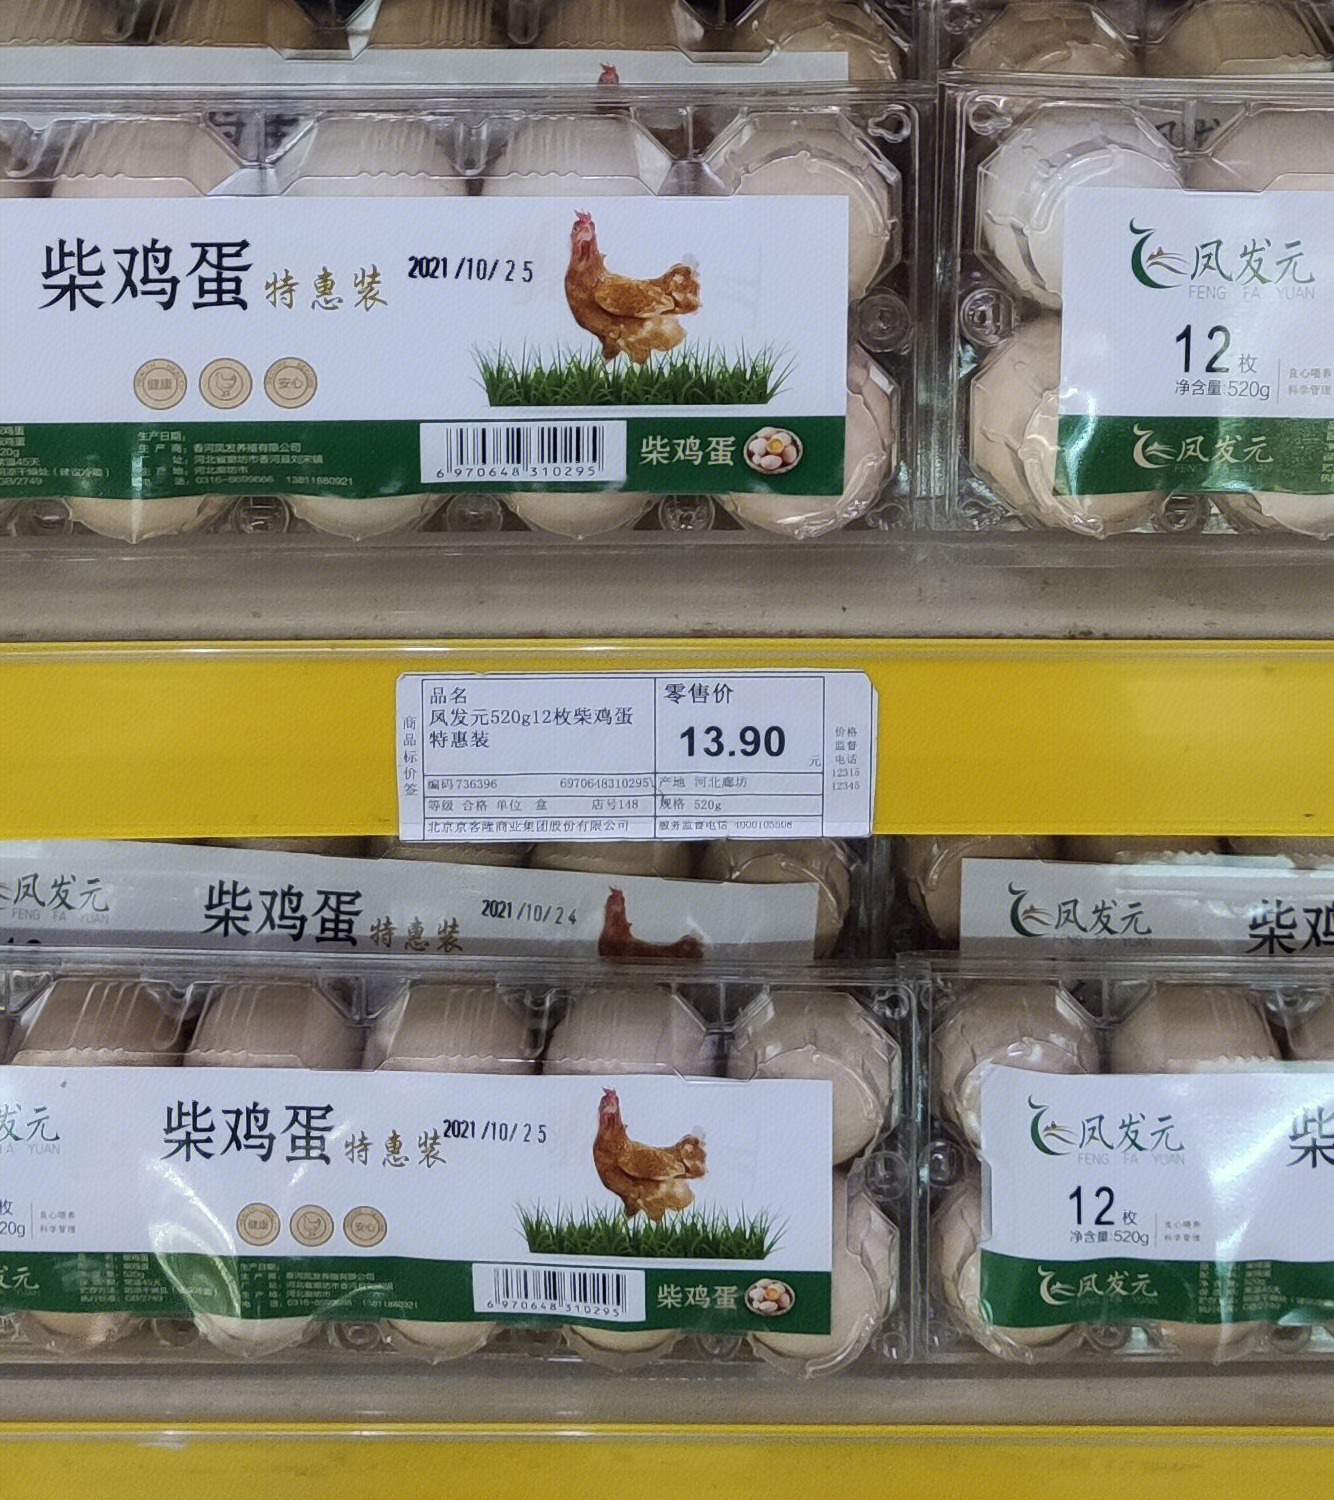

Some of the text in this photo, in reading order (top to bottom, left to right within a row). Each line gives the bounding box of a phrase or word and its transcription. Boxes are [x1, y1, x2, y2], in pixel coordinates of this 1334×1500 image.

[38, 237, 254, 313] 柴鸡蛋
[1190, 237, 1316, 286] 凤发元
[264, 263, 388, 312] 特惠装
[1190, 285, 1315, 300] FENG FA YUAN
[639, 435, 736, 467] 柴鸡蛋
[1176, 435, 1274, 464] 凤发元
[430, 683, 734, 704] 品名 零售价
[429, 731, 489, 748] 特惠装
[835, 726, 857, 737] 价格
[835, 740, 857, 751] 监督
[402, 715, 417, 796] 商品标价签
[680, 726, 821, 767] 13.90 元
[836, 754, 856, 764] 电话
[695, 776, 747, 788] 河北廊坊
[832, 767, 860, 777] 12315
[429, 799, 454, 810] 等级
[462, 799, 488, 810] 合格
[497, 799, 522, 810] 单位
[536, 799, 548, 810] 盒
[660, 798, 721, 811] 规格 520g
[14, 873, 110, 913] 凤发元
[200, 880, 364, 947] 柴鸡蛋
[1055, 899, 1153, 936] 凤发元
[370, 917, 463, 953] 特惠装
[161, 1100, 334, 1163] 柴鸡蛋
[1079, 1113, 1185, 1152] 凤发元
[28, 1143, 60, 1155] YUAN
[344, 1128, 446, 1168] 特惠装
[1078, 1152, 1184, 1165] FENG FA YUAN
[657, 1284, 738, 1309] 柴鸡蛋
[1078, 1269, 1158, 1298] 凤发元
